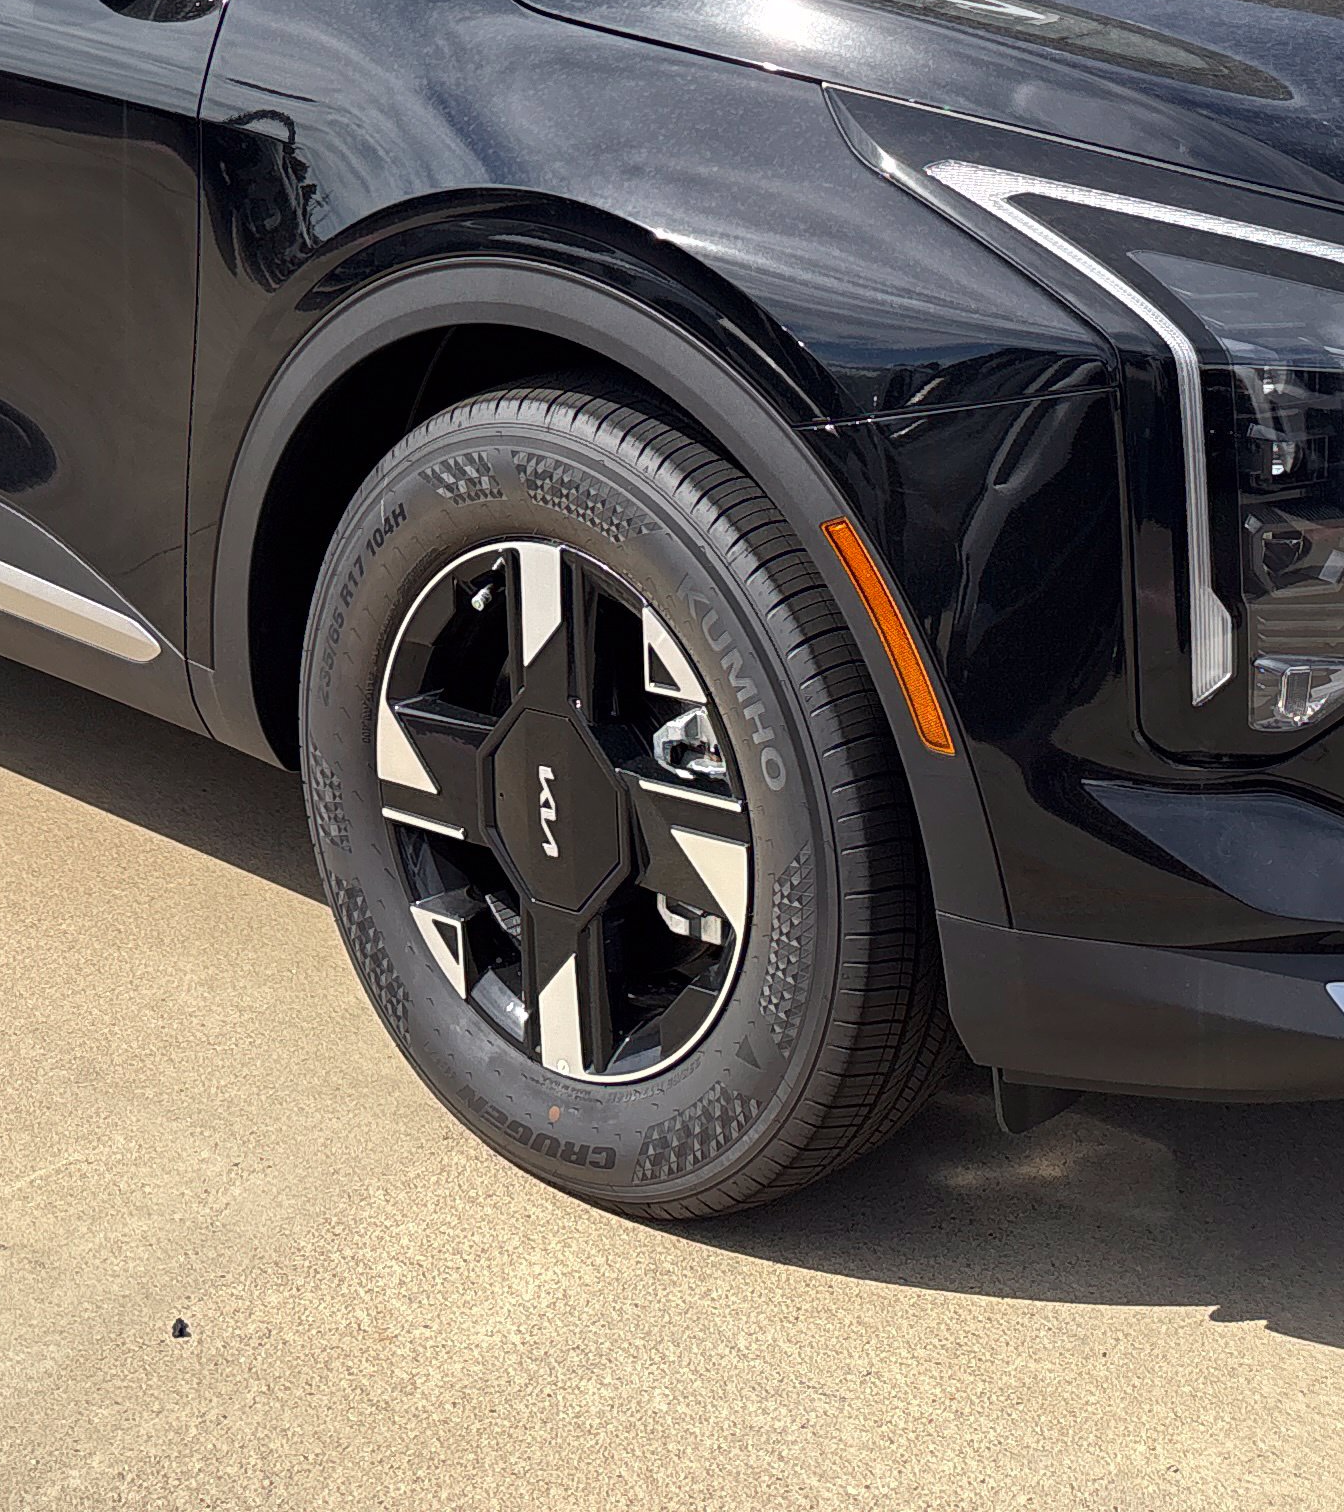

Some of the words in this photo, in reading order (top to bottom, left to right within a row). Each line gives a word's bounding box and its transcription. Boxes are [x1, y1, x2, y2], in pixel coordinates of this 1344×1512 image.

[340, 554, 365, 608] R17
[366, 502, 407, 557] 104H
[676, 572, 786, 791] KUMHO
[456, 1083, 616, 1170] CRUGEN
